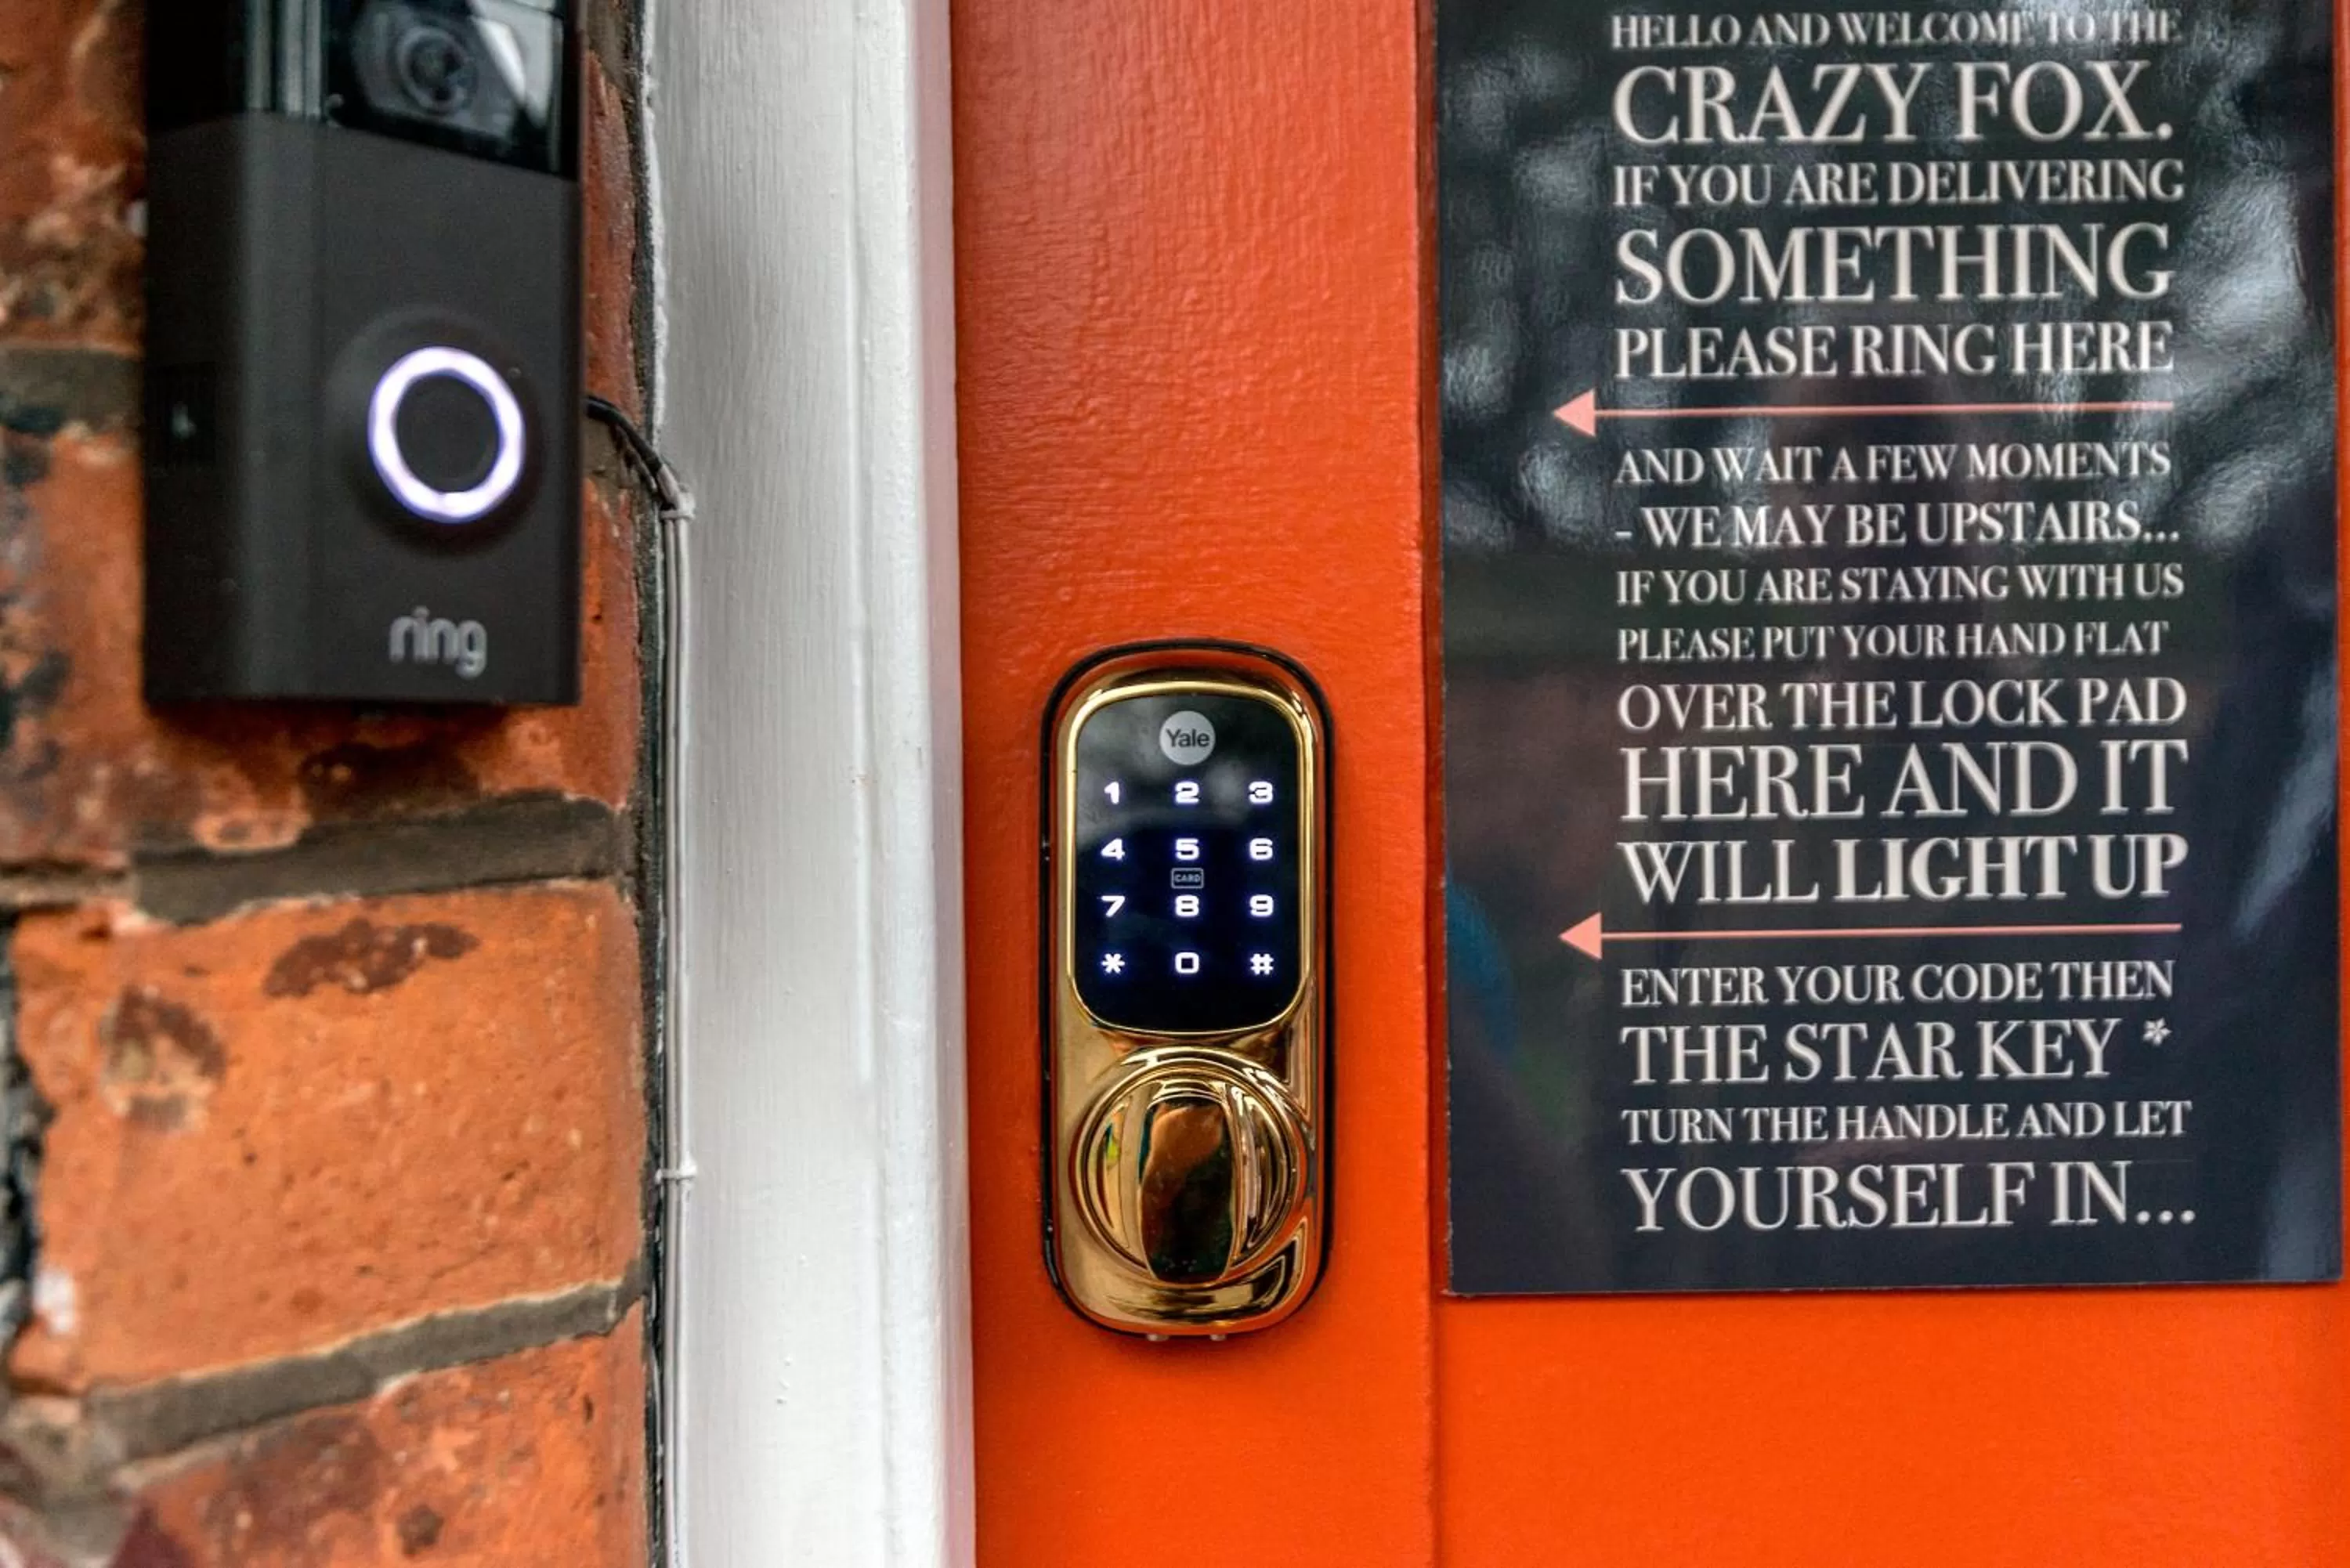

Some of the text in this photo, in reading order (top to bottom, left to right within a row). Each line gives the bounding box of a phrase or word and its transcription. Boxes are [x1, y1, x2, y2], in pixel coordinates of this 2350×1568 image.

[1612, 9, 2182, 50] HELLO AND WELCOME TO THE
[1614, 60, 2174, 145] CRAZY FOX.
[1613, 158, 2184, 208] IF YOU ARE DELIVERING
[1615, 222, 2175, 306] SOMETHING
[1615, 321, 2174, 379] PLEASE RING HERE
[1615, 441, 2171, 486] AND WAIT A FEW MOMENTS
[1641, 507, 1722, 548] WE
[1732, 504, 1836, 547] MAY
[1845, 504, 1906, 545] BE
[1617, 563, 2184, 605] IF YOU ARE STAYING WITH US
[389, 605, 487, 678] ring
[1618, 621, 2167, 661] PLEASE PUT YOUR HAND FLAT
[1618, 677, 2189, 732] OVER THE LOCK PAD
[1166, 728, 1210, 747] Yale
[1104, 782, 1273, 804] 1 2 3
[1619, 739, 2189, 823] HERE AND IT
[1101, 839, 1273, 861] 4 5 6
[1618, 833, 2189, 905] WILL LIGHT UP
[1175, 873, 1201, 883] CARD
[1101, 894, 1274, 917] 7 8 9
[1621, 959, 2175, 1009] ENTER YOUR CODE THEN
[1621, 1025, 1768, 1085] THE
[1784, 1021, 1963, 1083] STAR
[1976, 1018, 2122, 1079] KEY
[1622, 1100, 2192, 1145] TURN THE HANDLE AND LET
[1621, 1162, 2037, 1232] YOURSELF
